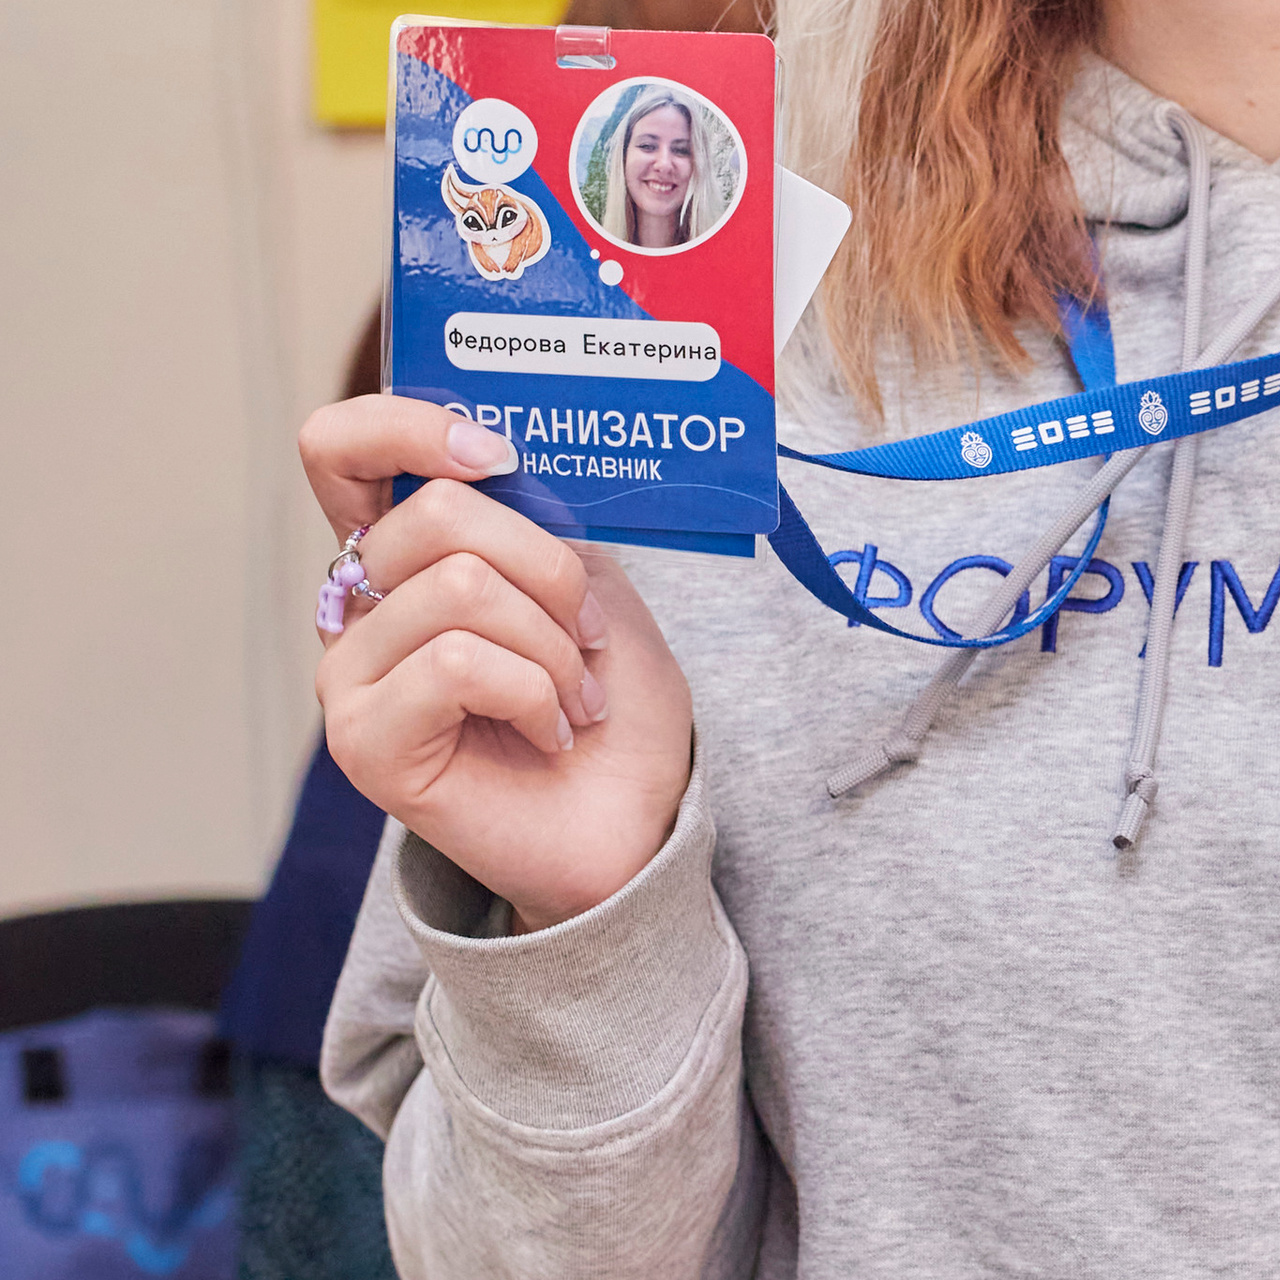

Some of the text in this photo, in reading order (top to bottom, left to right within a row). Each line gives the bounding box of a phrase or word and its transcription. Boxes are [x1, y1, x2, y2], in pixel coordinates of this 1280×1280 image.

[449, 328, 717, 363] Федорова Екатерина
[523, 452, 663, 481] НАСТАВНИК
